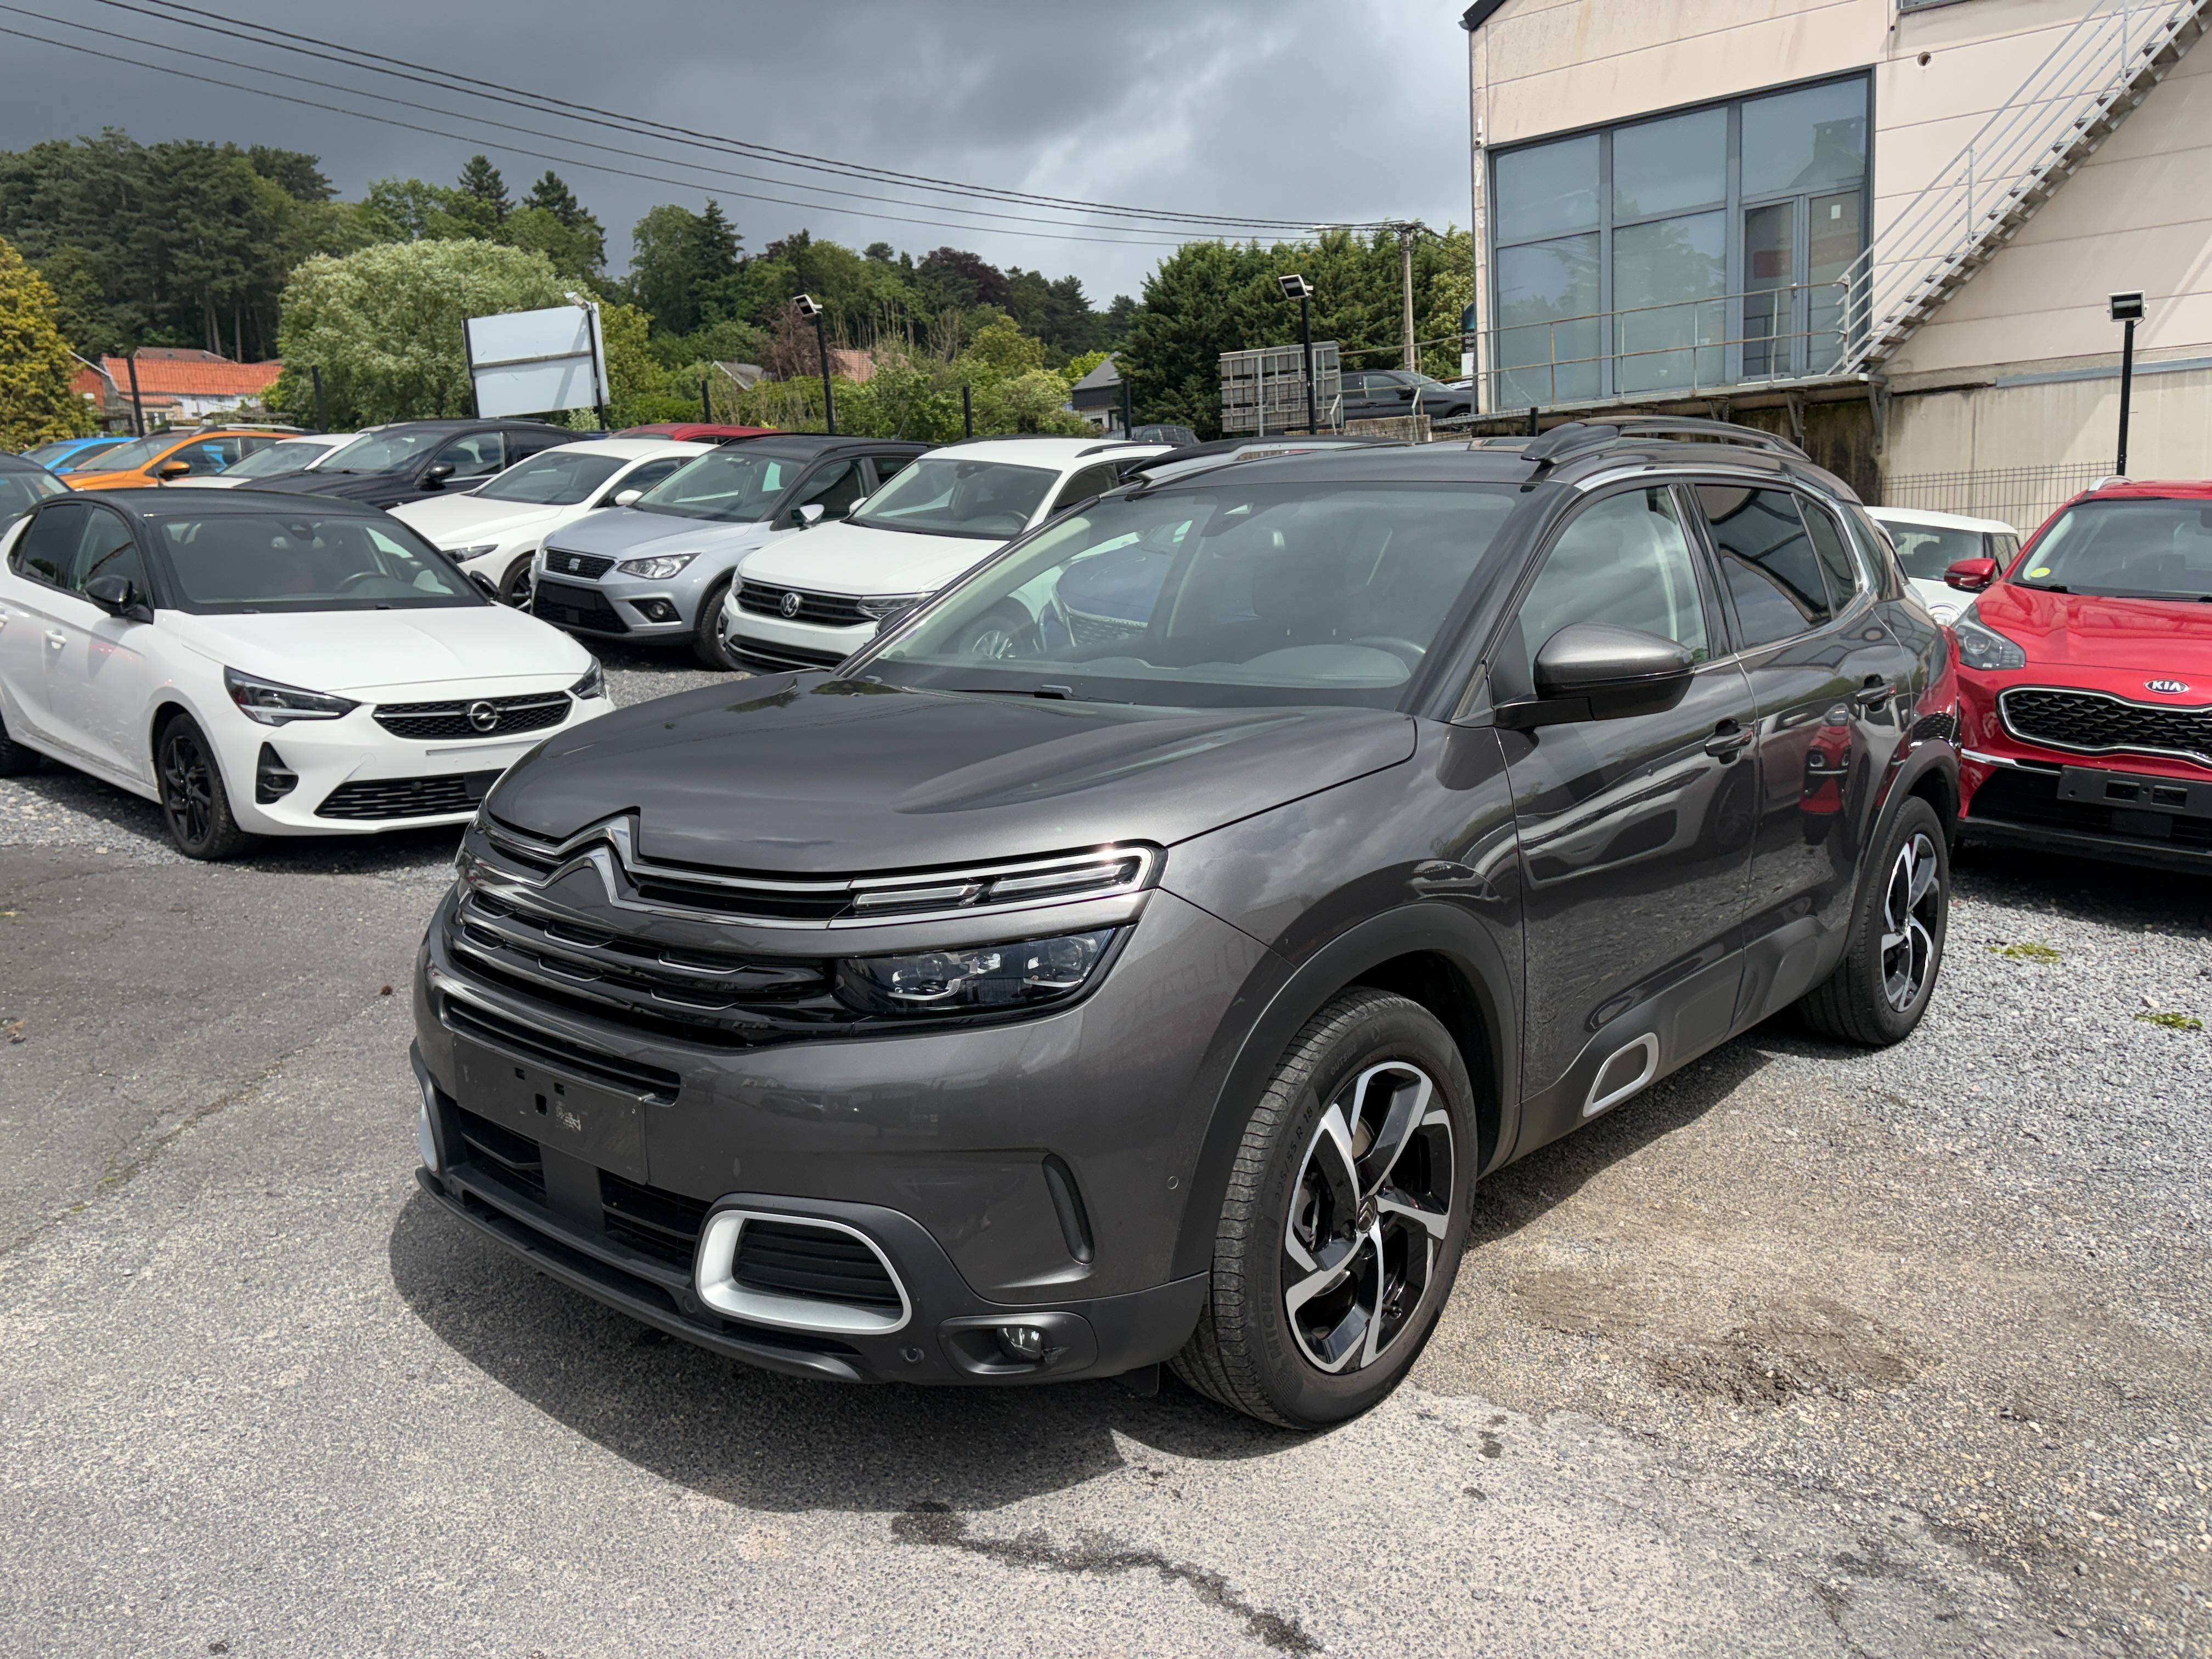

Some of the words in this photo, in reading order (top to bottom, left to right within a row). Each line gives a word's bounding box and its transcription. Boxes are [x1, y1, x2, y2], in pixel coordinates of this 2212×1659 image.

[2152, 681, 2181, 691] KIA
[1330, 1043, 1357, 1075] OUTSIDE
[1274, 1141, 1297, 1202] 225/55
[1296, 1126, 1304, 1139] R
[1304, 1106, 1313, 1123] 18
